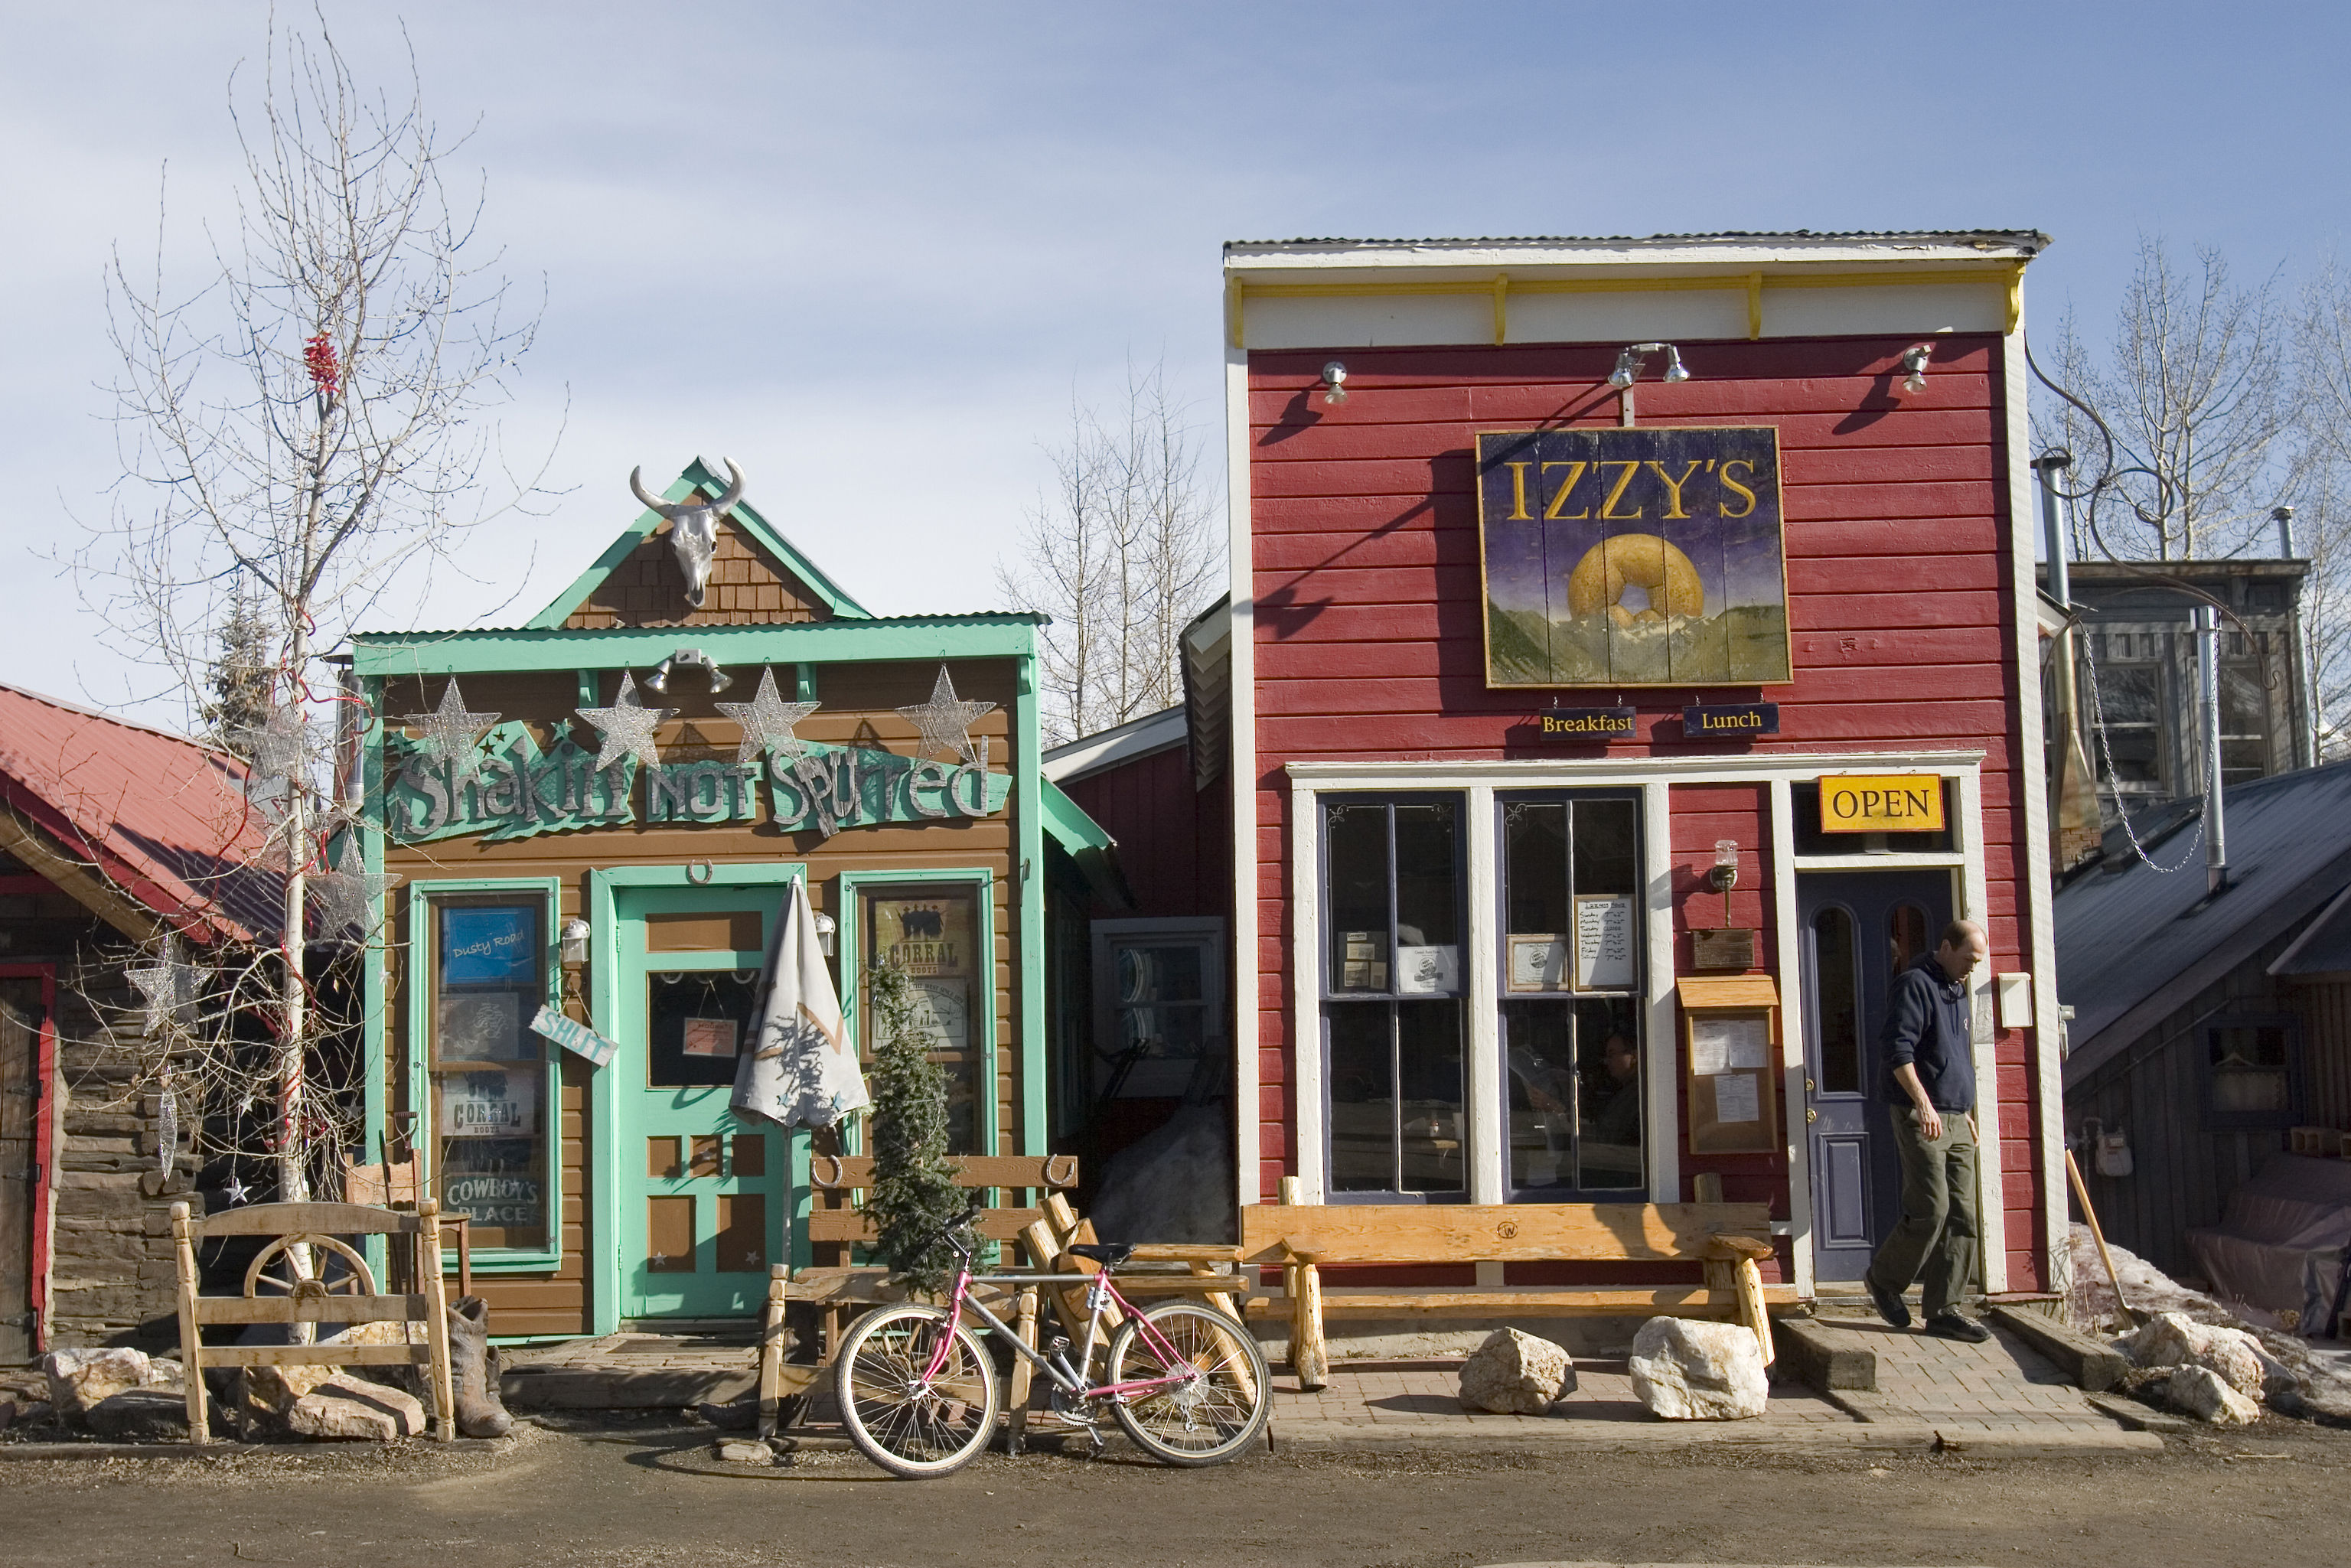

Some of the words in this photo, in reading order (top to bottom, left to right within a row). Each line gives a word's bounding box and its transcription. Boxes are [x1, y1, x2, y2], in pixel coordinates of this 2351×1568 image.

[1504, 459, 1756, 520] IZZY'S
[1543, 715, 1634, 732] Breakfast
[1702, 712, 1762, 729] Lunch
[651, 768, 757, 814] NOT
[1833, 790, 1929, 818] OPEN
[453, 942, 491, 960] Dusty
[890, 944, 958, 969] CORRAL
[536, 1012, 609, 1061] SHUT
[454, 1103, 520, 1129] CORRAL
[447, 1178, 538, 1205] COWBOY'S
